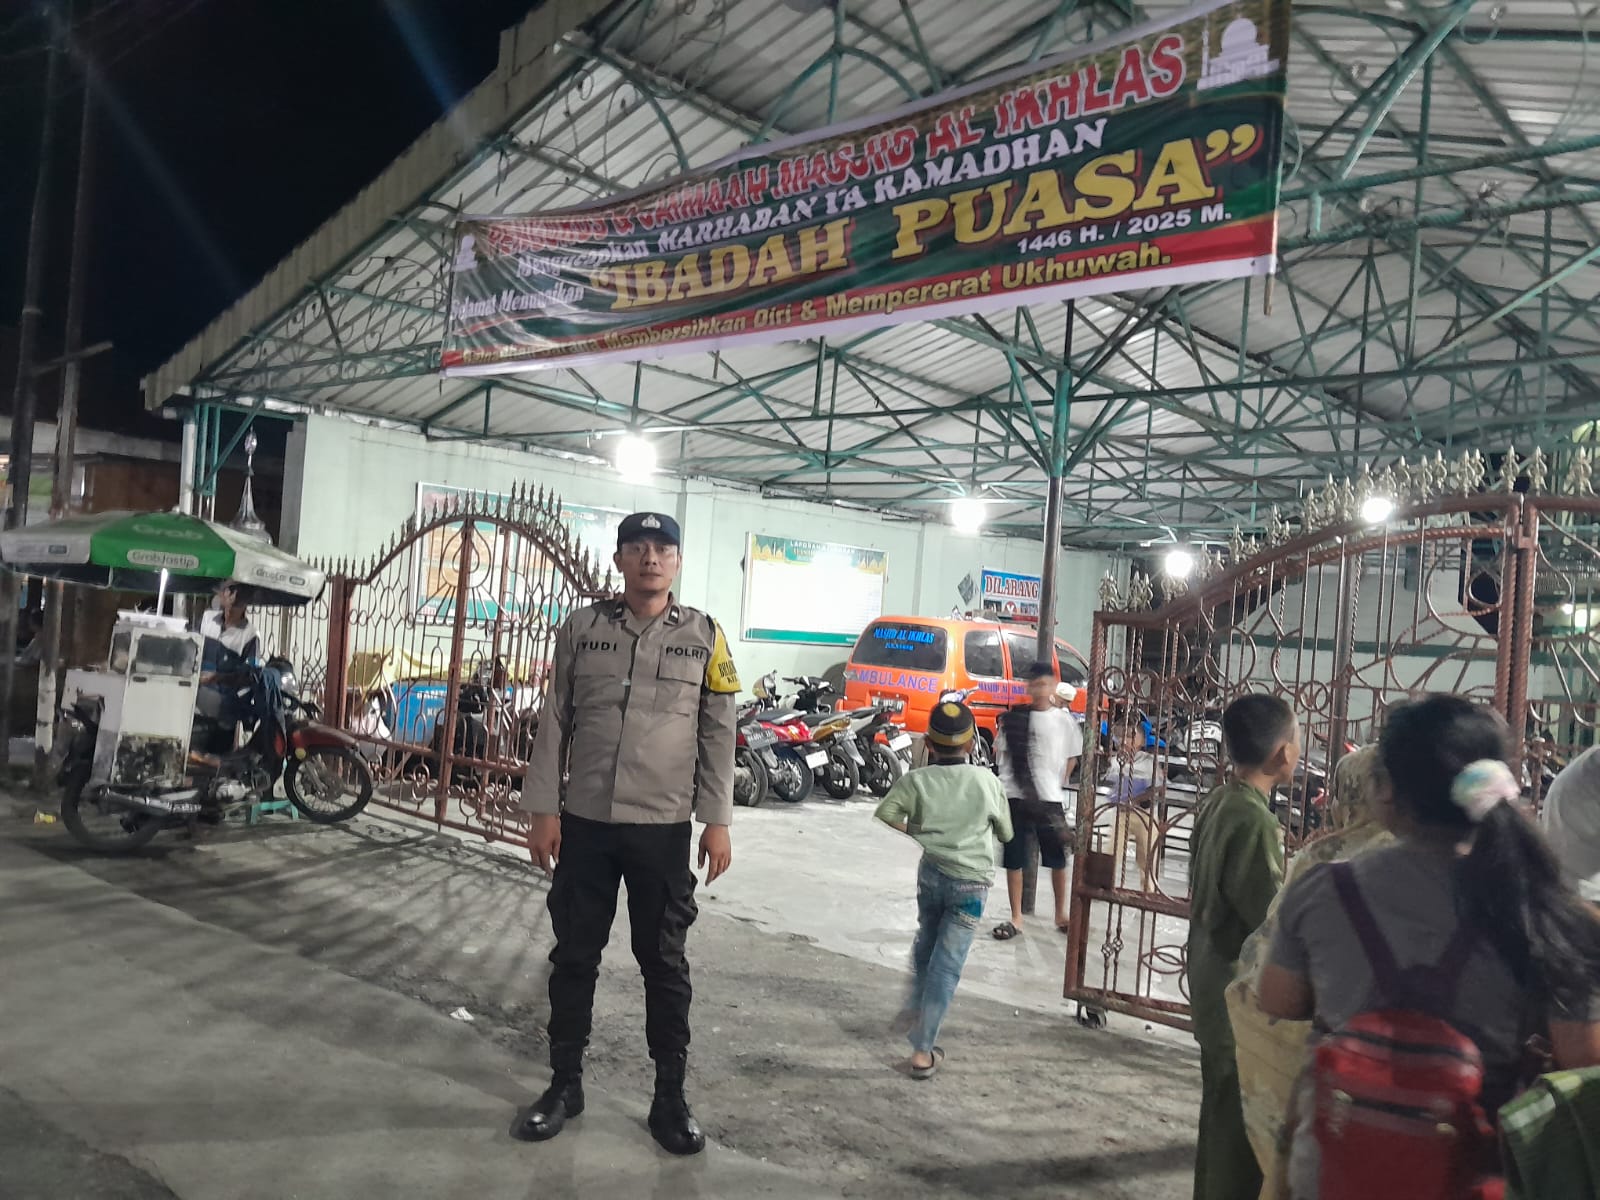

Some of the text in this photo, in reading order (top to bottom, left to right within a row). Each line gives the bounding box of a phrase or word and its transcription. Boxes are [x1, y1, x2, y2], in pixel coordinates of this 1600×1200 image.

[771, 125, 919, 200] MASJID
[924, 103, 985, 161] AL
[993, 32, 1185, 137] IKHLAS
[657, 195, 818, 253] MARHABAN
[1017, 202, 1233, 254] 1446 H. / 2025 M.
[605, 314, 747, 350] Membersihkan
[753, 303, 793, 327] Diri
[800, 299, 818, 321] &
[826, 268, 992, 316] Mempererat
[1001, 242, 1171, 290] Ukhuwah.
[132, 523, 204, 540] Grab
[985, 575, 1039, 598] DILARANG
[578, 640, 618, 652] YUDI
[907, 630, 935, 644] IKHLAS
[665, 645, 705, 660] POLRI
[850, 668, 939, 694] MBULANCE
